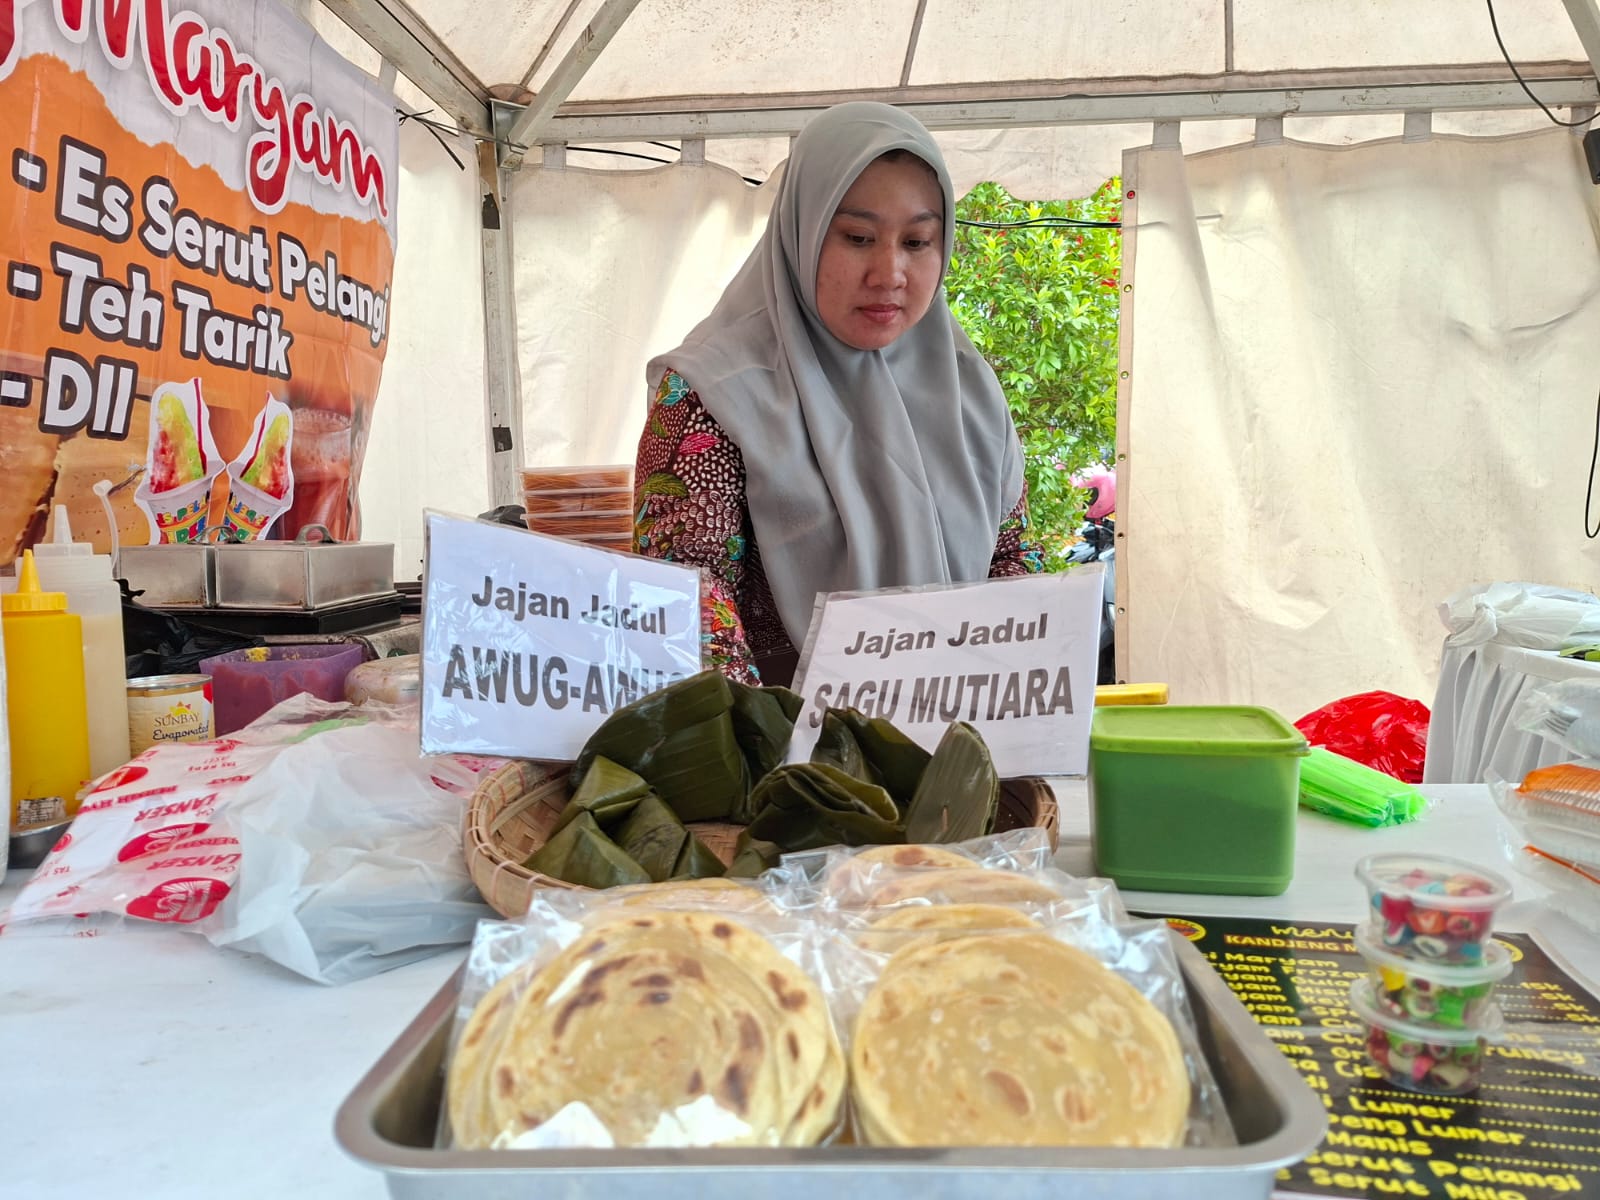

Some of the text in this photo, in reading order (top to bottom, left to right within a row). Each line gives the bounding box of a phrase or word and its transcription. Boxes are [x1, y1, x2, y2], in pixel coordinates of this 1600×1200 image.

[58, 138, 132, 240] Es
[143, 179, 271, 289] Serut
[279, 235, 391, 345] Pelangi
[53, 247, 164, 348] Teh
[173, 285, 292, 378] Tarik
[41, 352, 136, 438] Dll
[471, 575, 667, 635] Jajan Jadul
[843, 612, 1049, 660] Jajan Jadul
[808, 665, 1075, 729] SAGU MUTIARA
[153, 711, 200, 728] SUNBAY
[133, 793, 219, 823] LANSER
[145, 853, 242, 871] LANSER
[1225, 934, 1339, 952] KANDJENG
[1348, 1094, 1456, 1120] Lumer
[1326, 1129, 1433, 1156] Manis
[1411, 1118, 1526, 1146] Lumer
[1307, 1166, 1431, 1197] Serut
[1427, 1159, 1583, 1192] Pelangi
